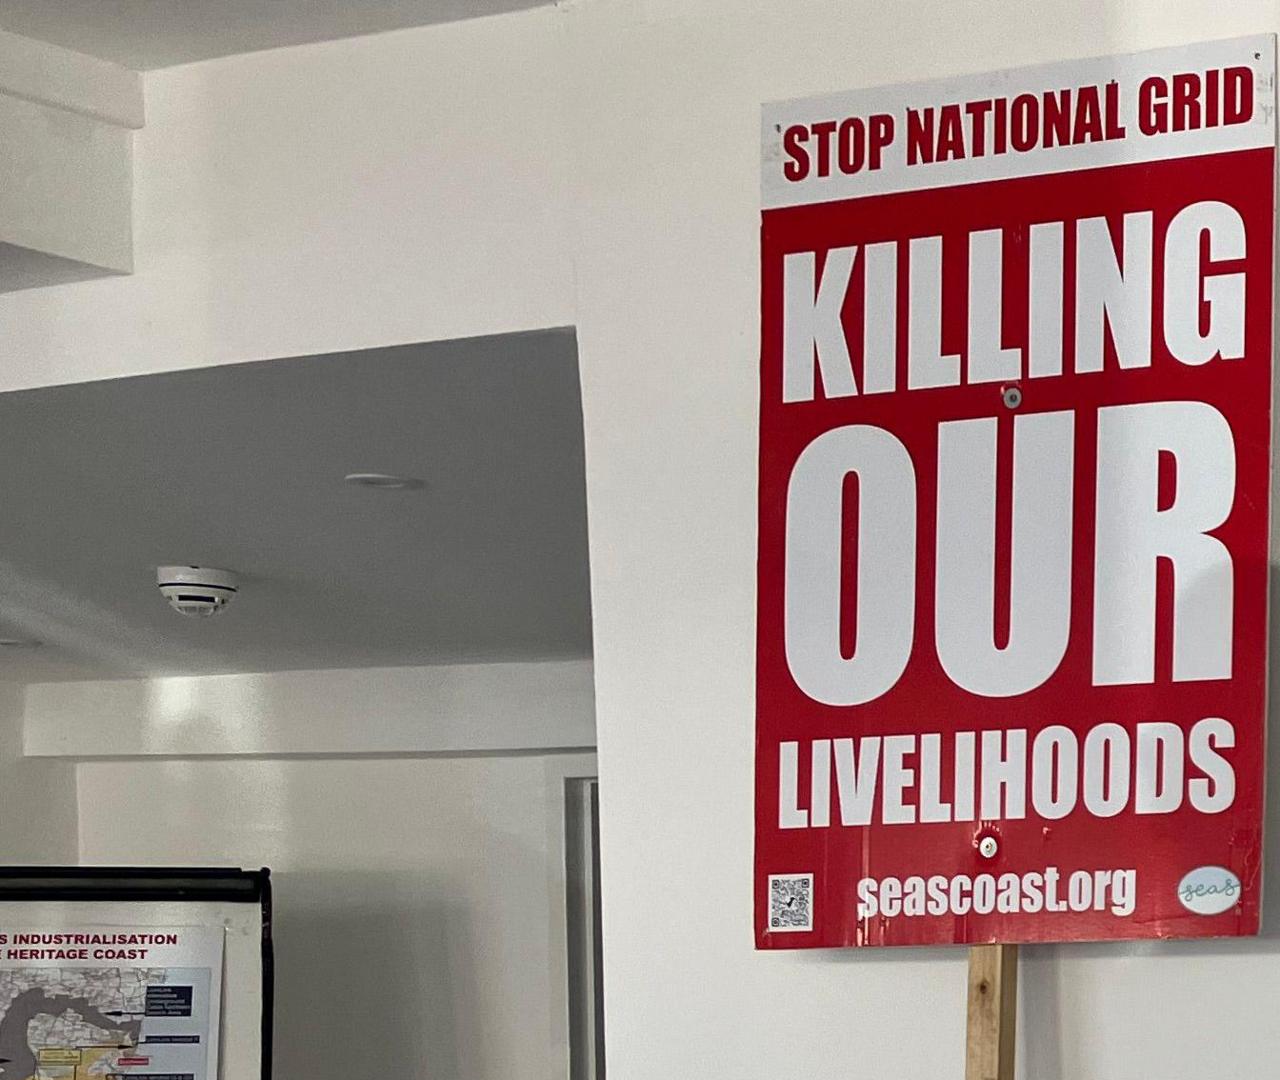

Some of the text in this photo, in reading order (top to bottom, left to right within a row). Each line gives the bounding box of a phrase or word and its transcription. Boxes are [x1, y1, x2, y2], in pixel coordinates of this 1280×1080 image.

[782, 66, 1254, 182] STOP NATIONAL GRID
[782, 200, 1246, 403] KILLING
[784, 400, 1236, 707] OUR
[778, 717, 1236, 829] LIVELIHOODS
[857, 866, 1137, 918] seascoast.org
[1180, 879, 1239, 902] seas
[7, 949, 148, 960] HERITAGE COAST
[13, 934, 178, 945] INDUSTRIALISATION
